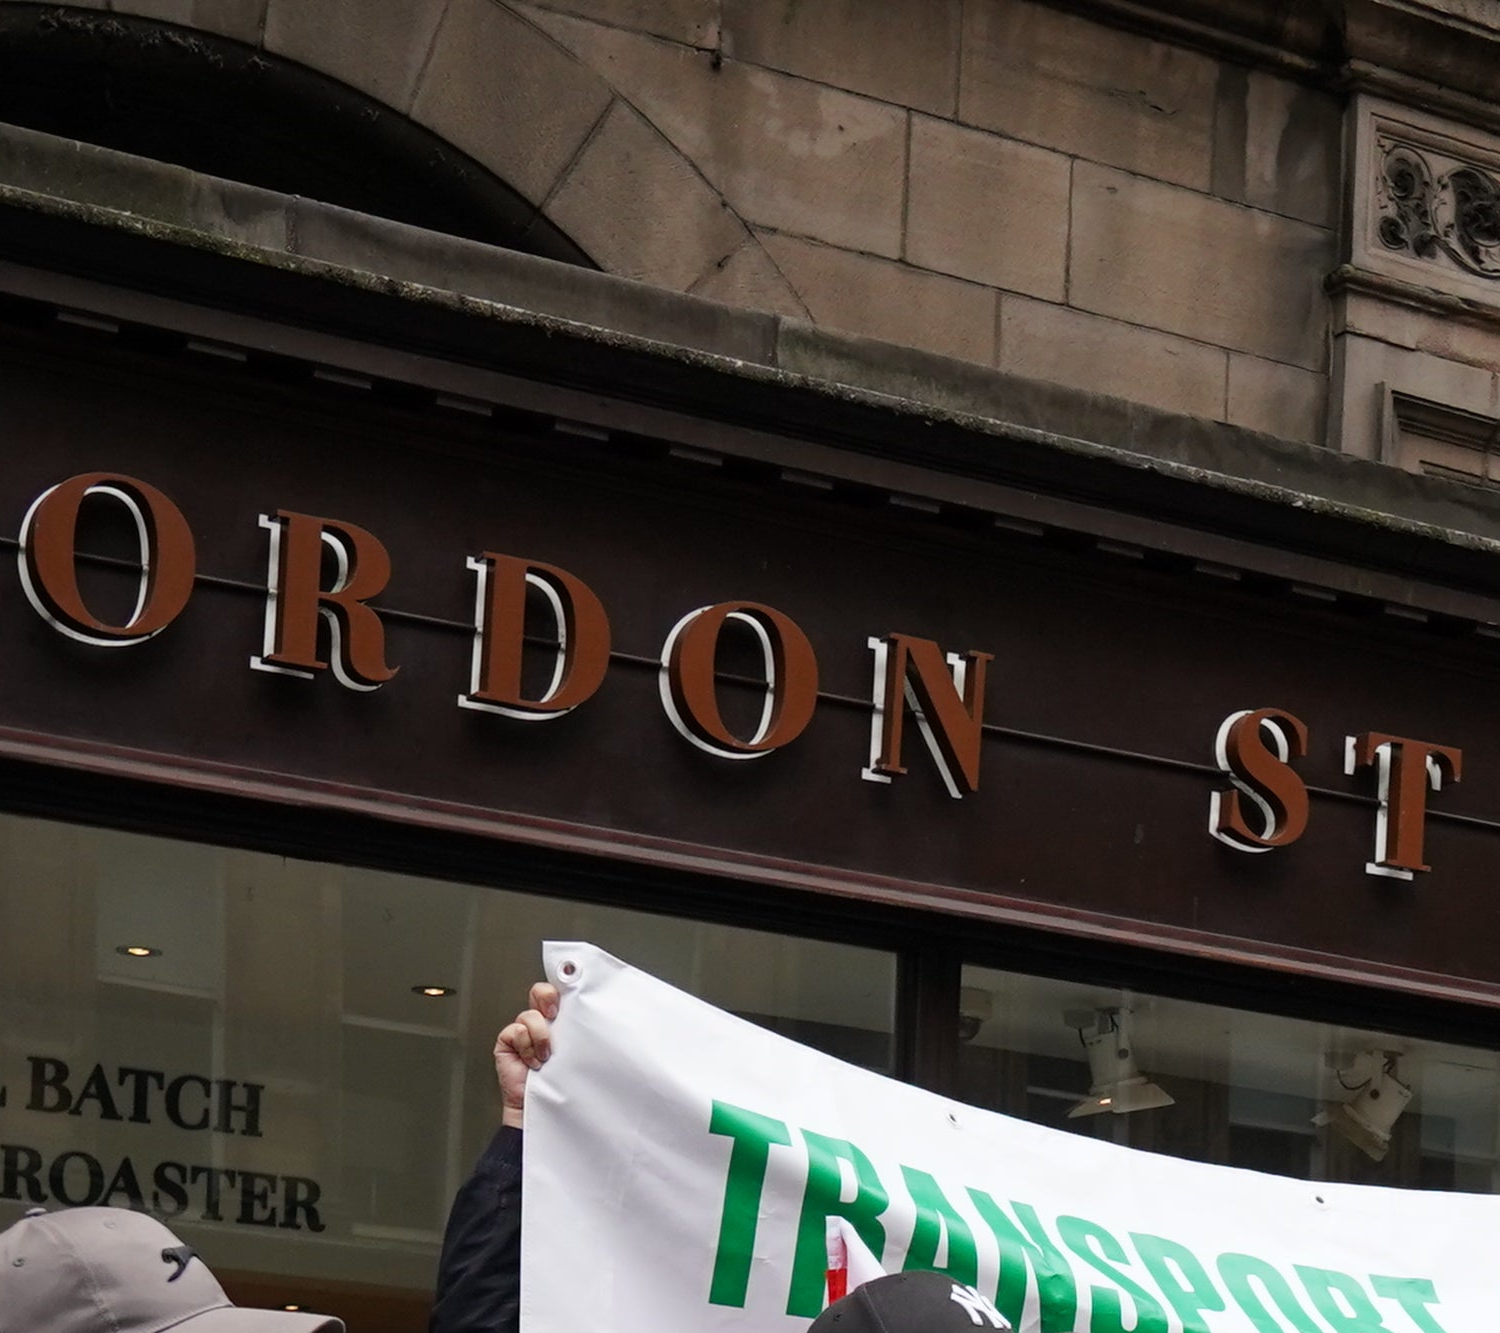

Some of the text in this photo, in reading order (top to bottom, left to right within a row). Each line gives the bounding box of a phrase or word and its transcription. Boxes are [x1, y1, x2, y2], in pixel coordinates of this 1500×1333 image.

[1208, 706, 1462, 882] ST
[26, 1055, 265, 1138] BATCH
[0, 1145, 326, 1233] ROASTER
